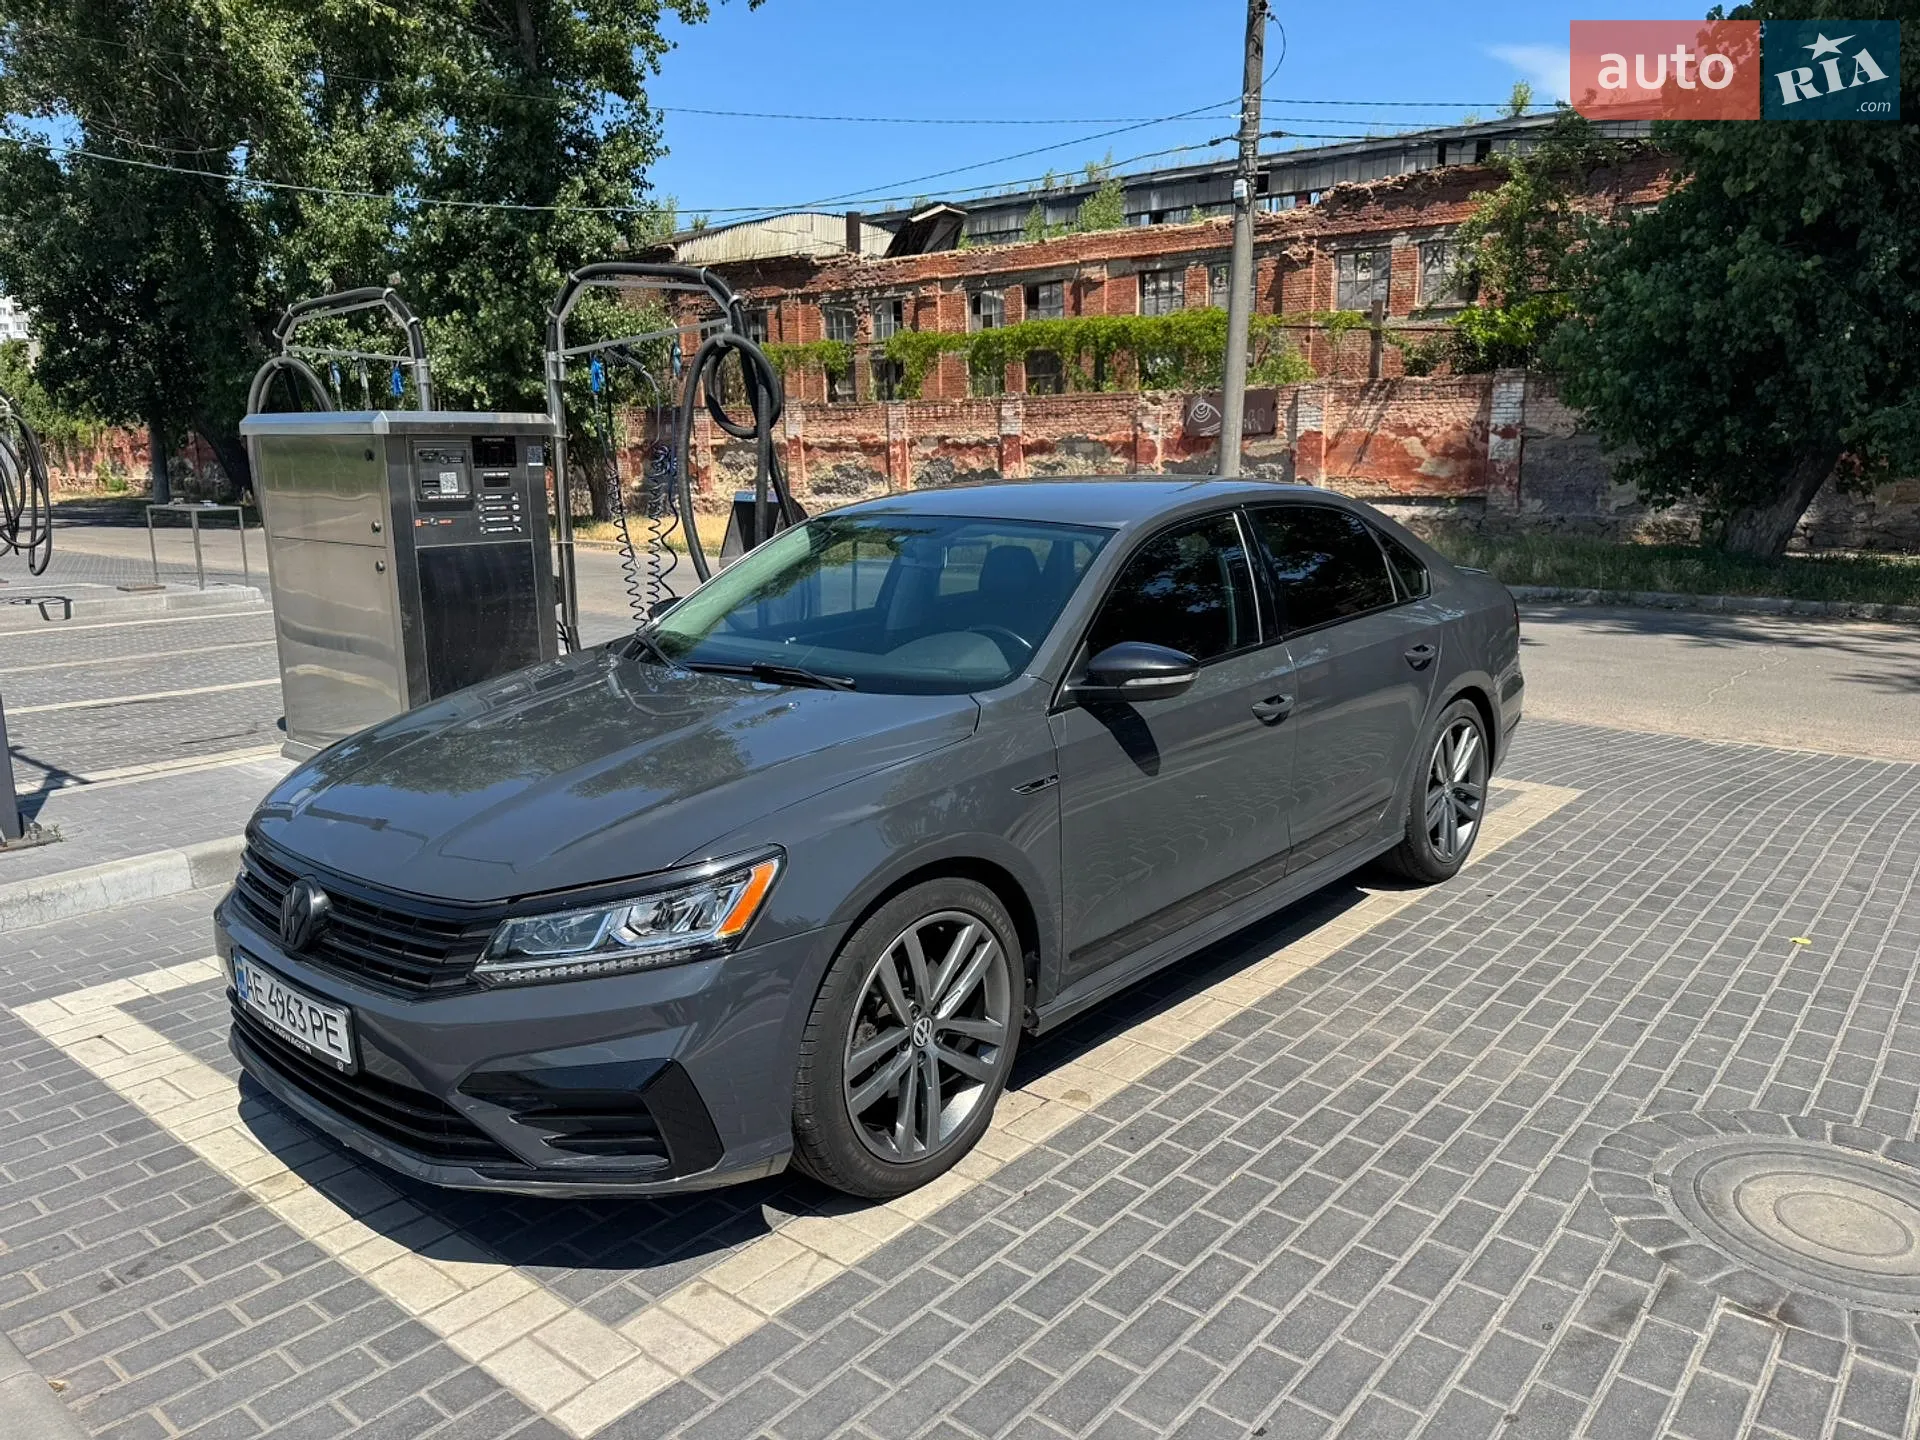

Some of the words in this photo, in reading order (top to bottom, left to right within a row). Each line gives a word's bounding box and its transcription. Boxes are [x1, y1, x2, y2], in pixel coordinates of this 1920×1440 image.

[246, 966, 267, 1010] AE
[268, 982, 307, 1034] 4963
[308, 1005, 343, 1053] PE
